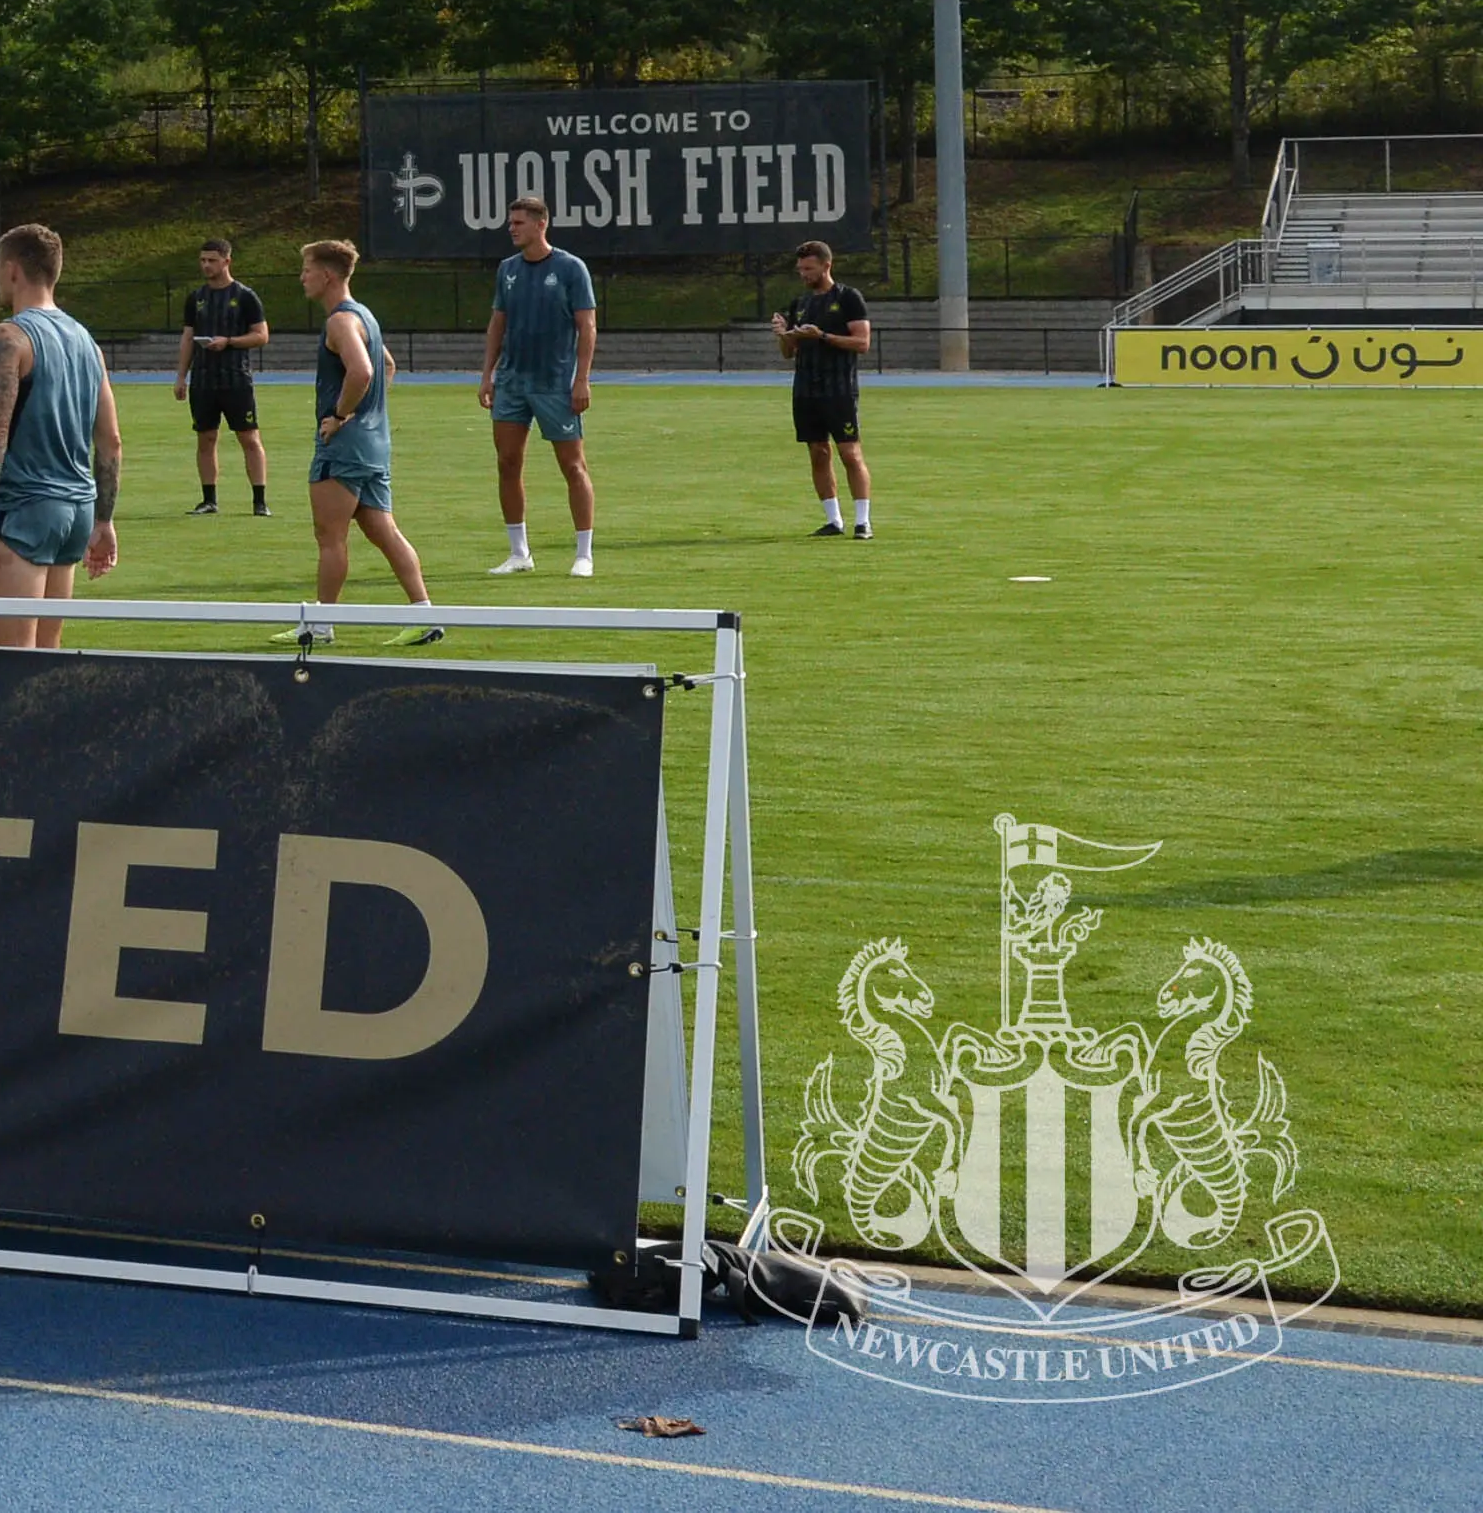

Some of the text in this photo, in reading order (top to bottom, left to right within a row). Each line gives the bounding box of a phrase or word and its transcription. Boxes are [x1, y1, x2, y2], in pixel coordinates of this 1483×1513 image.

[547, 110, 751, 136] WELCOME TO
[459, 143, 846, 230] WALSH FIELD
[1161, 344, 1277, 371] noon
